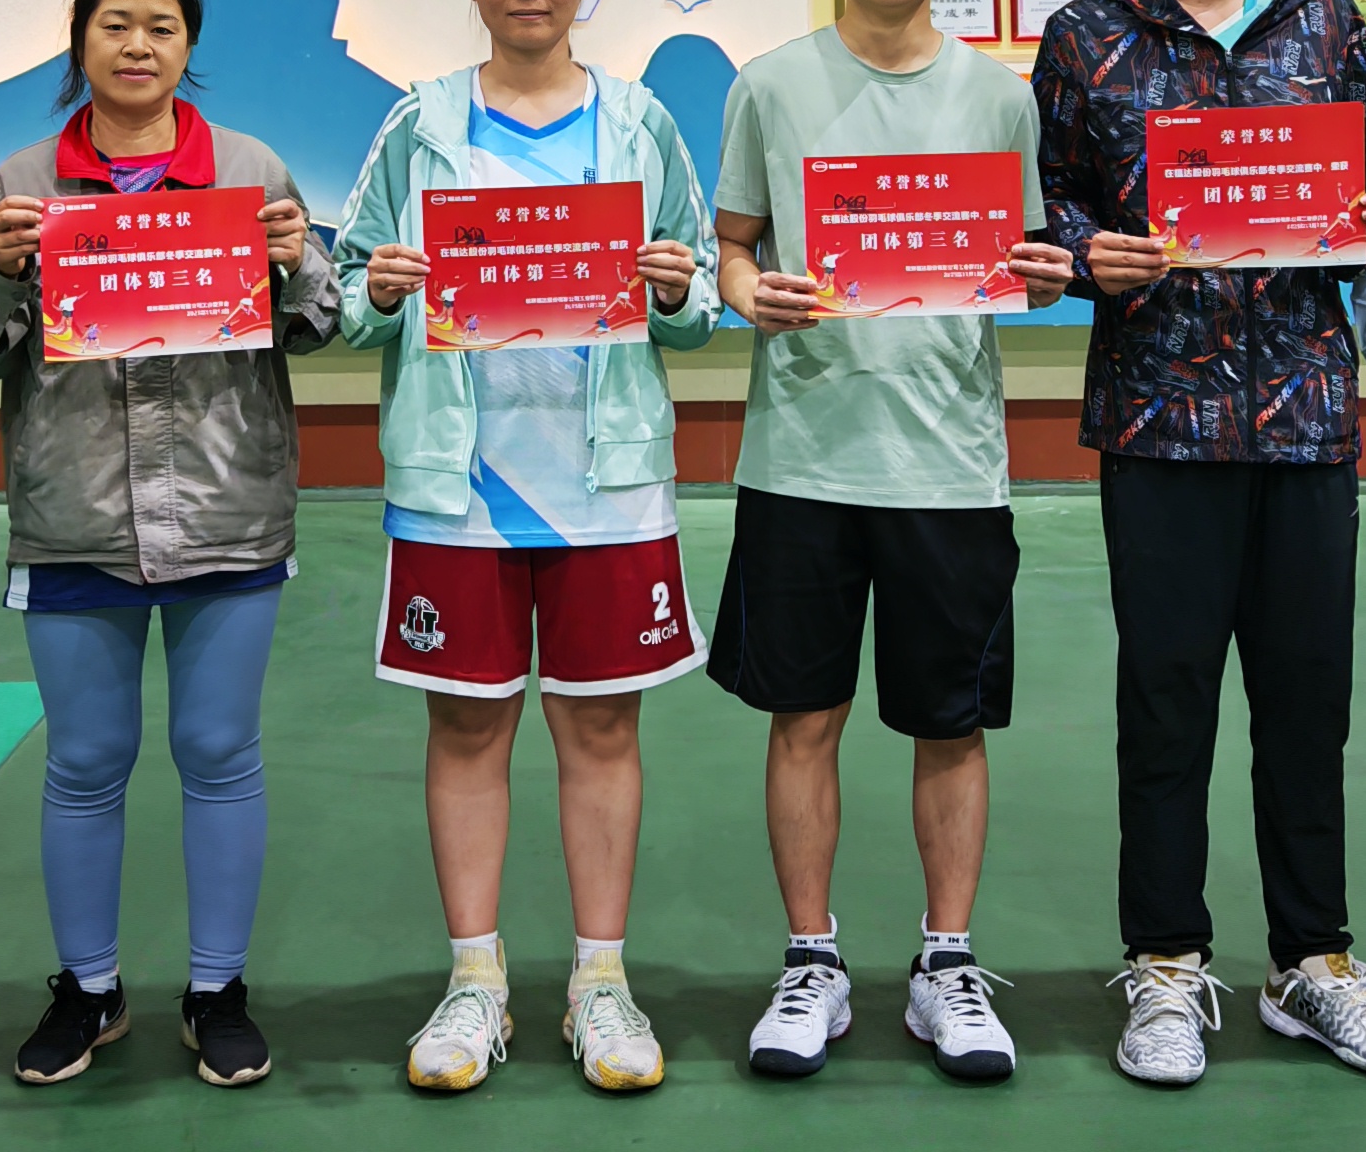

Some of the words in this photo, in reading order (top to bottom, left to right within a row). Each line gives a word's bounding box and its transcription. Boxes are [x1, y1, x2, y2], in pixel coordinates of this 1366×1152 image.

[1220, 128, 1293, 144] 荣誉奖状
[876, 174, 950, 190] 荣誉奖状
[1204, 183, 1313, 204] 团体第三名
[116, 212, 192, 230] 荣誉奖状
[496, 206, 570, 222] 荣誉奖状
[860, 231, 970, 251] 团体第三名
[100, 268, 214, 292] 团体第三名
[480, 262, 591, 283] 团体第三名
[652, 581, 671, 622] 2
